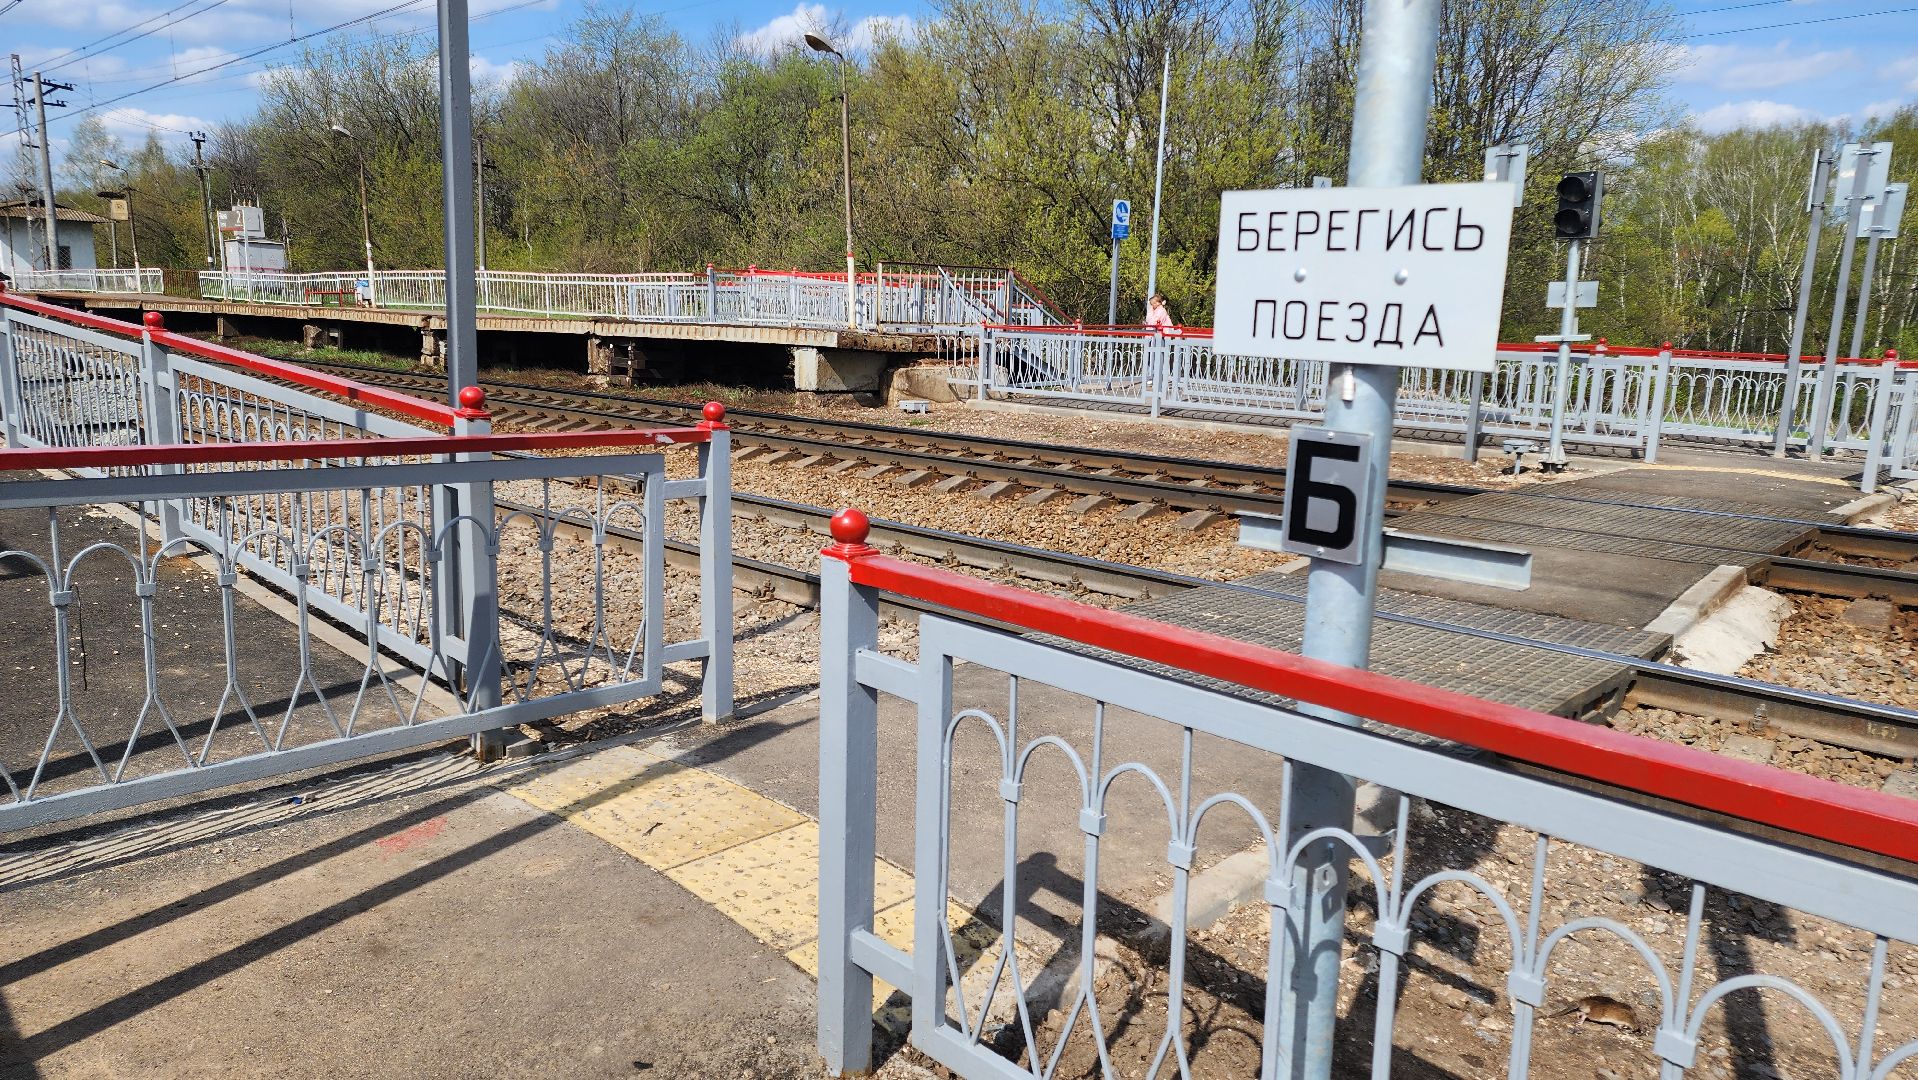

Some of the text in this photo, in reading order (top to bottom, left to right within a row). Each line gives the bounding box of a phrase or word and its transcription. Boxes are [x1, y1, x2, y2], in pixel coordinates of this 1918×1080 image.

[1237, 208, 1485, 252] БЕРЕГИСЬ
[1252, 299, 1444, 350] ПОЕЗДА
[1287, 438, 1361, 551] Б
